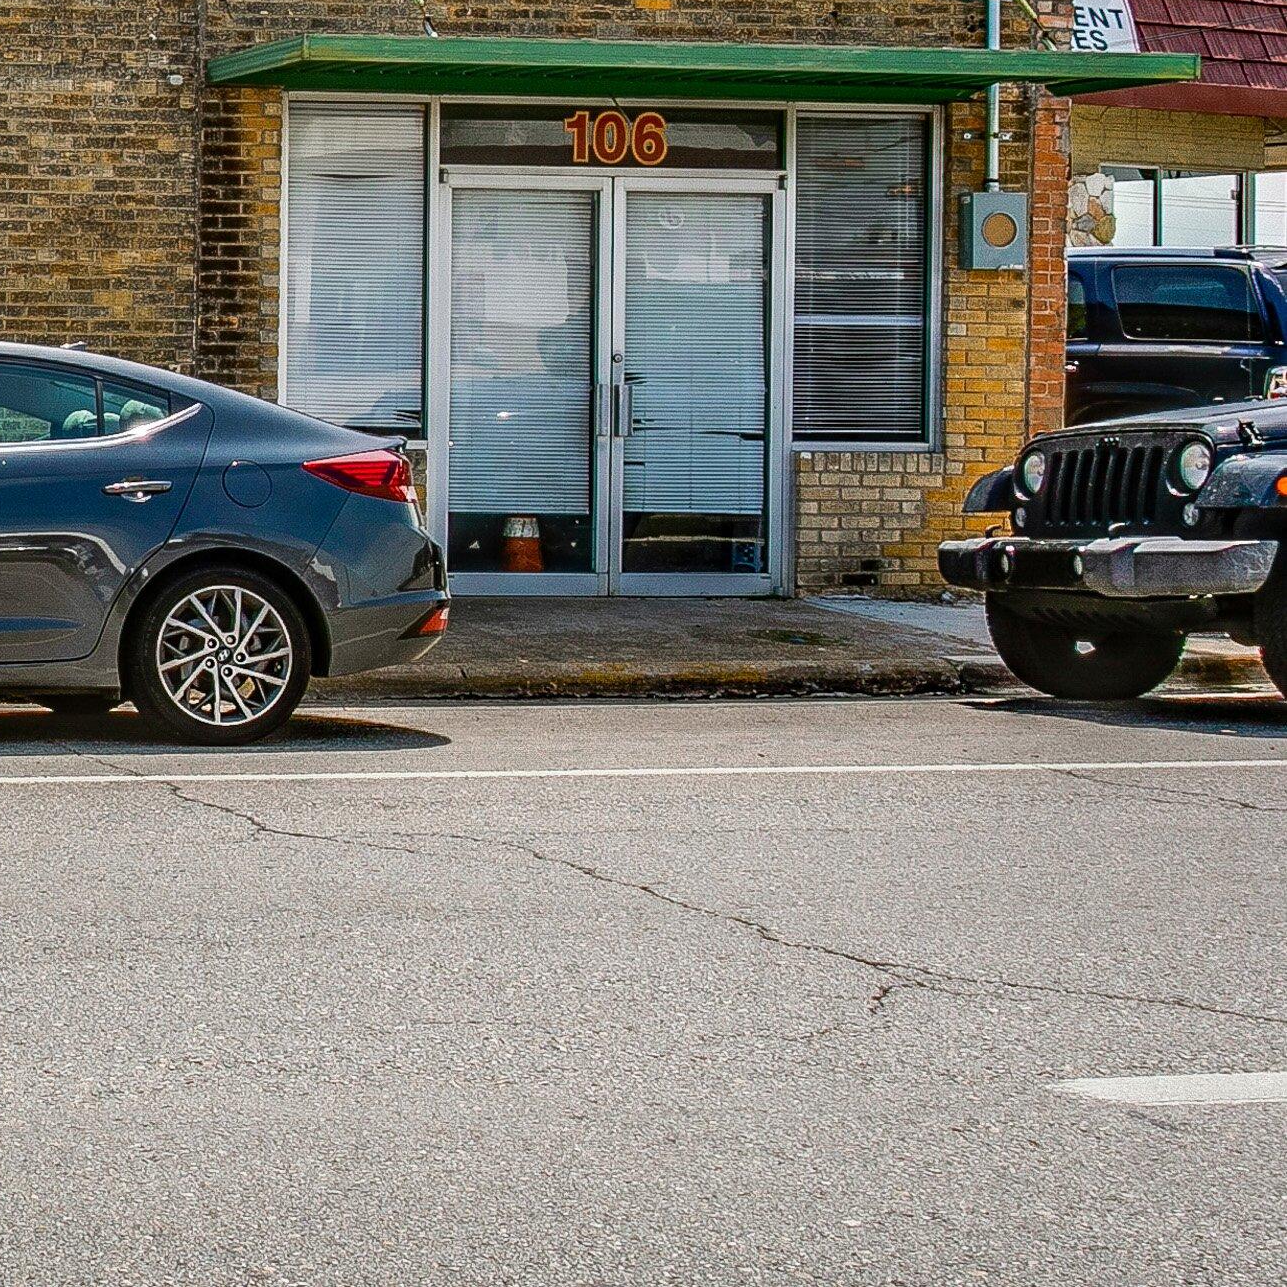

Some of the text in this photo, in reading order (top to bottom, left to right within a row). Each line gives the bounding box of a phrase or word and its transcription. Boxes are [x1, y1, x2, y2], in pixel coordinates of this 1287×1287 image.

[1074, 6, 1123, 29] ENT
[1073, 29, 1108, 51] ES
[564, 111, 667, 165] 106
